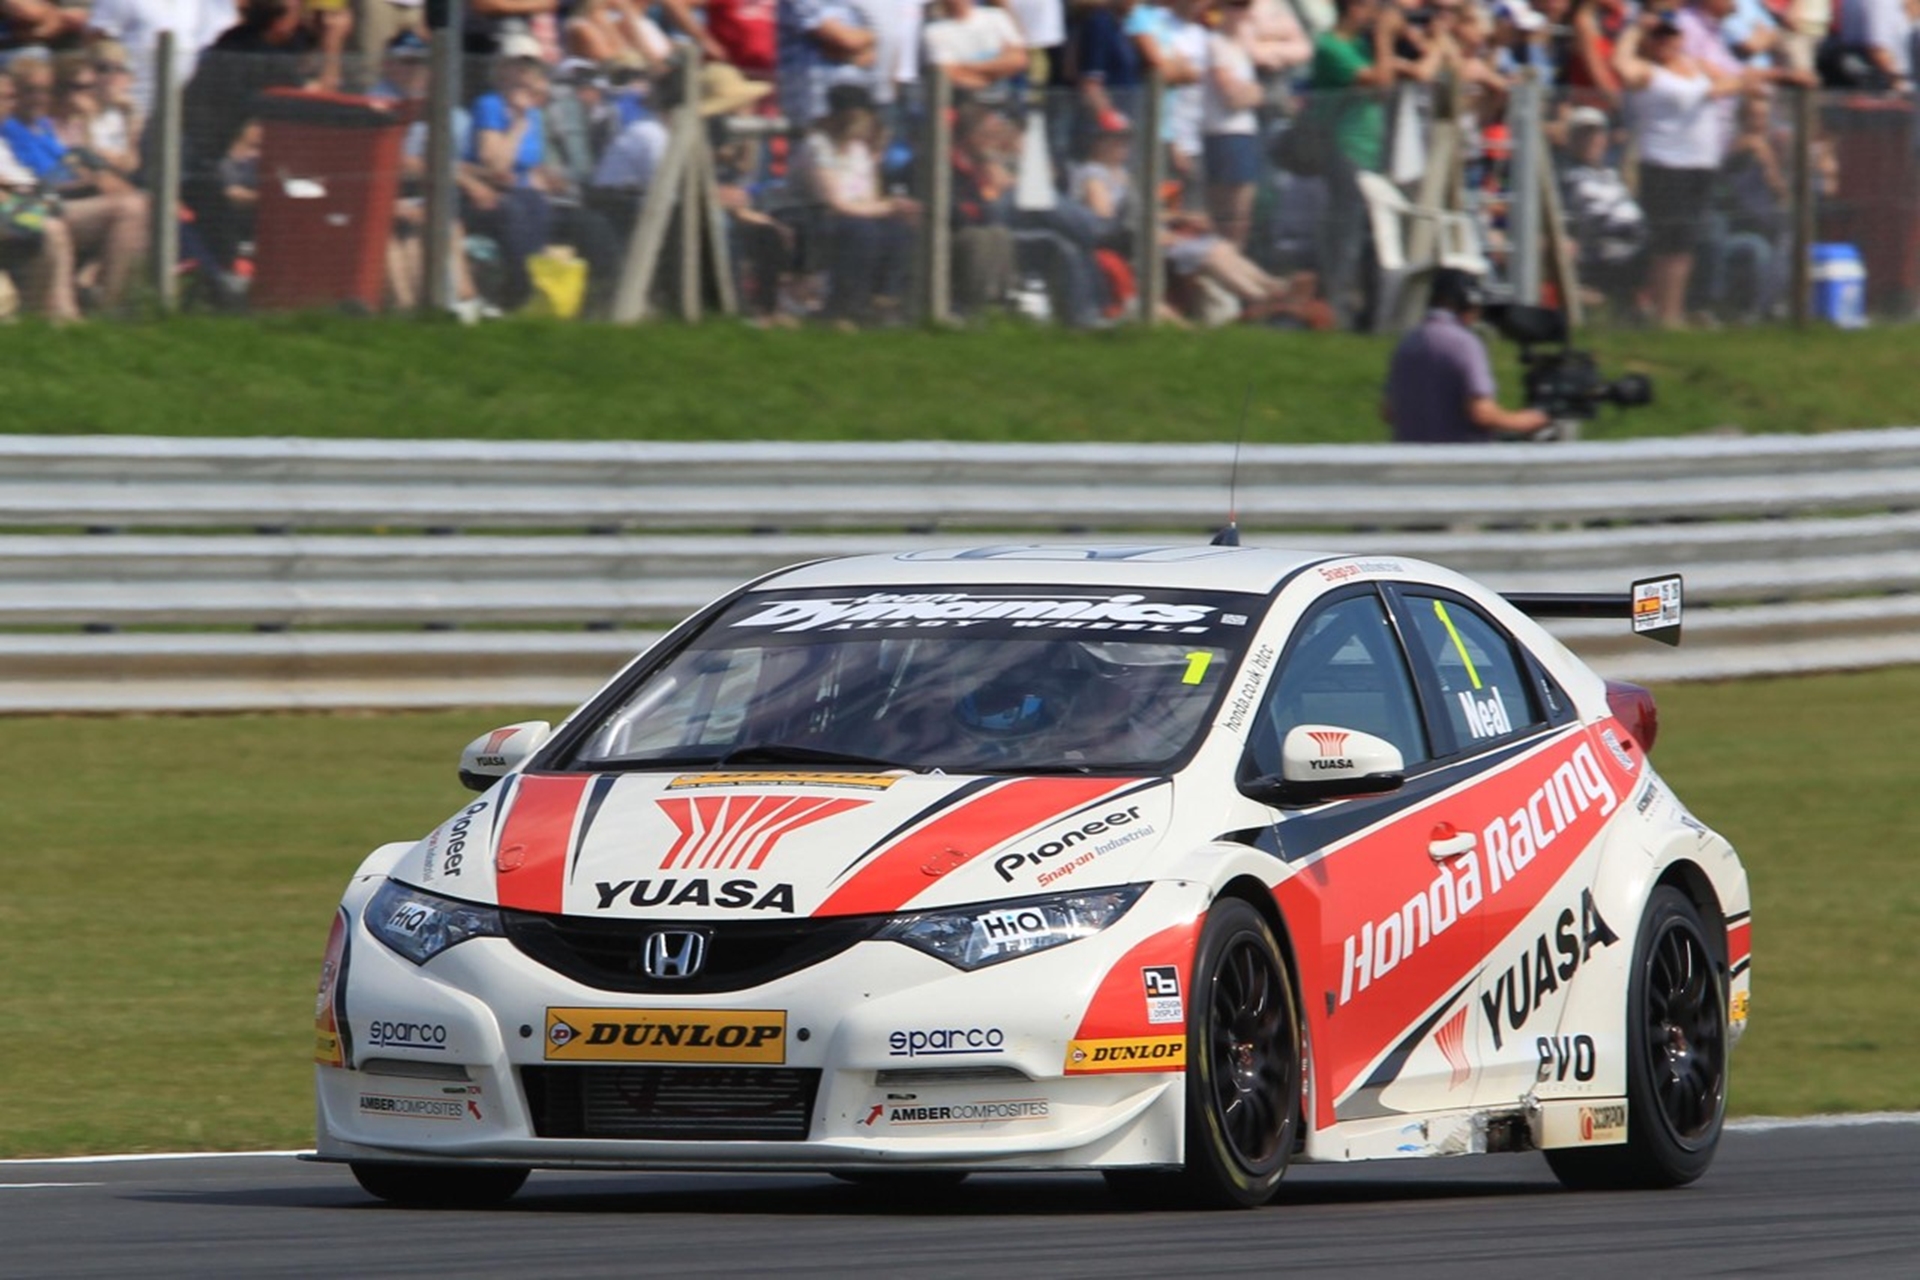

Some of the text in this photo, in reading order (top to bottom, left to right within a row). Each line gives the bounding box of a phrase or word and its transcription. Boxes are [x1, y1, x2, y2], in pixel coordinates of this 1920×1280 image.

[728, 594, 1219, 633] Dynamics
[818, 619, 1210, 633] ALLOY WHEELS
[1433, 600, 1483, 690] 1
[1181, 651, 1214, 685] 1
[1457, 686, 1513, 739] Neal
[476, 756, 507, 767] YUASA
[1309, 759, 1355, 770] YUASA
[444, 801, 489, 877] Pioneer
[993, 806, 1142, 883] Pioneer
[1036, 825, 1156, 888] Snap-on Industrial
[1339, 741, 1618, 1006] Honda Racing
[595, 878, 796, 913] YUASA
[388, 905, 428, 929] HiQ
[983, 911, 1047, 938] HiQ
[1481, 886, 1620, 1052] YUASA
[369, 1020, 447, 1048] sparco
[584, 1022, 783, 1048] DUNLOP
[888, 1027, 1004, 1057] sparco
[1091, 1043, 1183, 1062] DUNLOP
